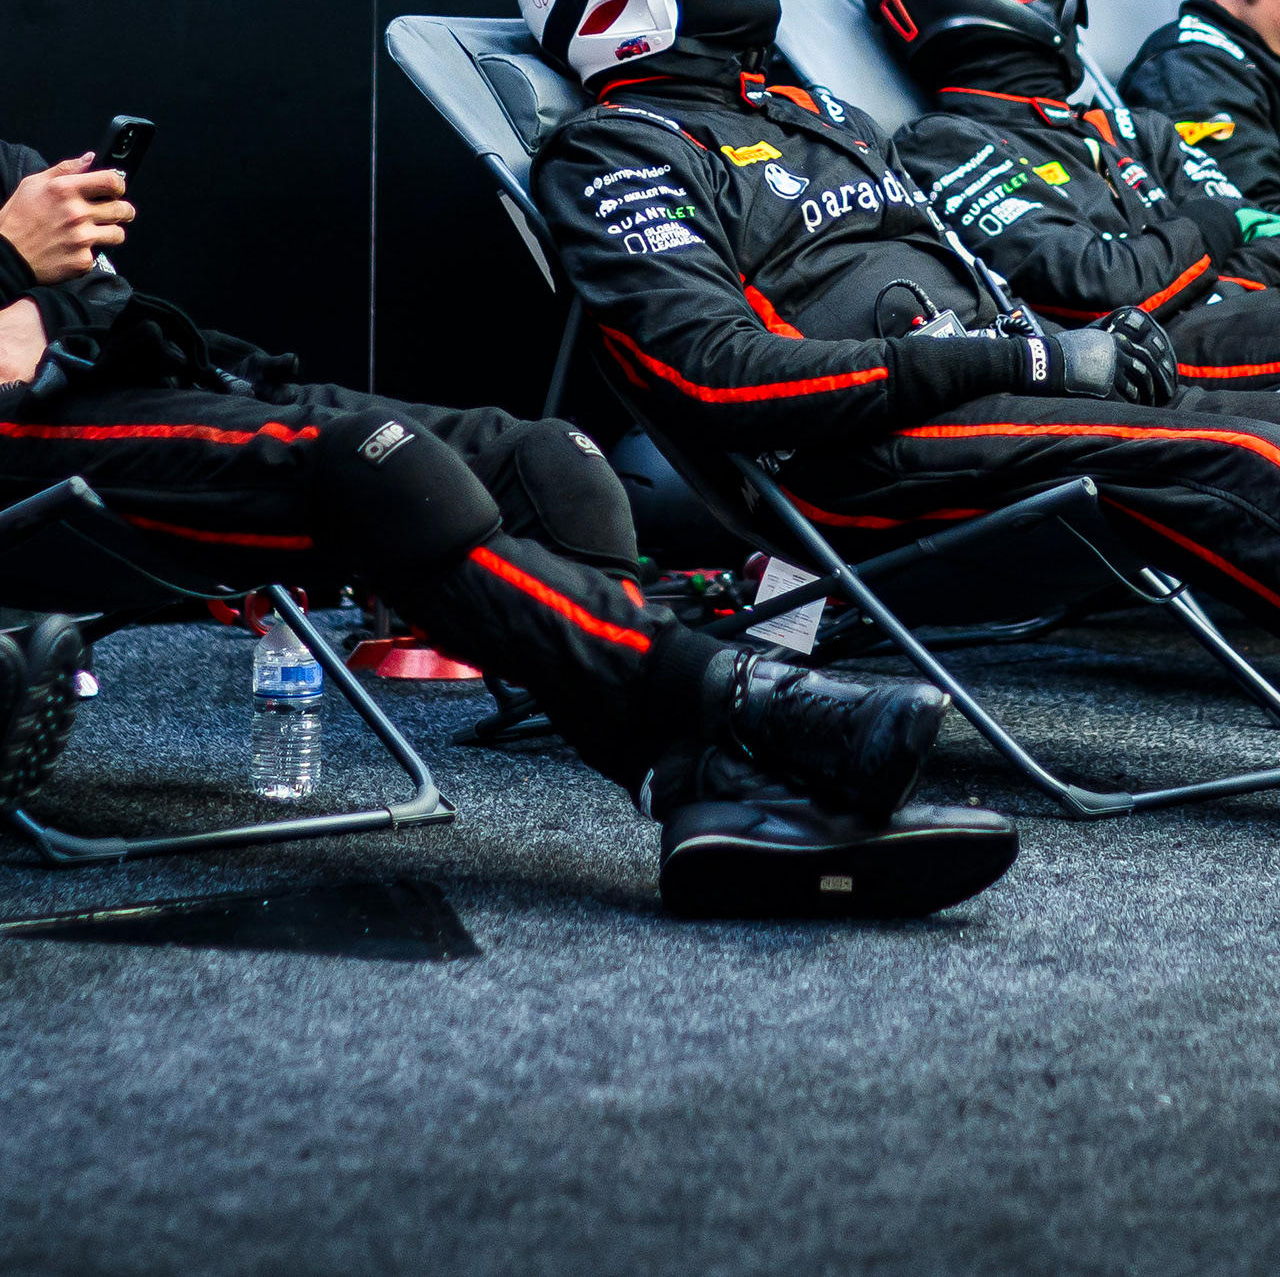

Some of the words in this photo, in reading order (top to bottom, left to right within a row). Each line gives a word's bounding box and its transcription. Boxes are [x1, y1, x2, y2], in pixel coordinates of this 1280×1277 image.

[961, 172, 1029, 226] QUANTLET
[607, 205, 696, 235] QUANTLET
[364, 423, 406, 460] OMP
